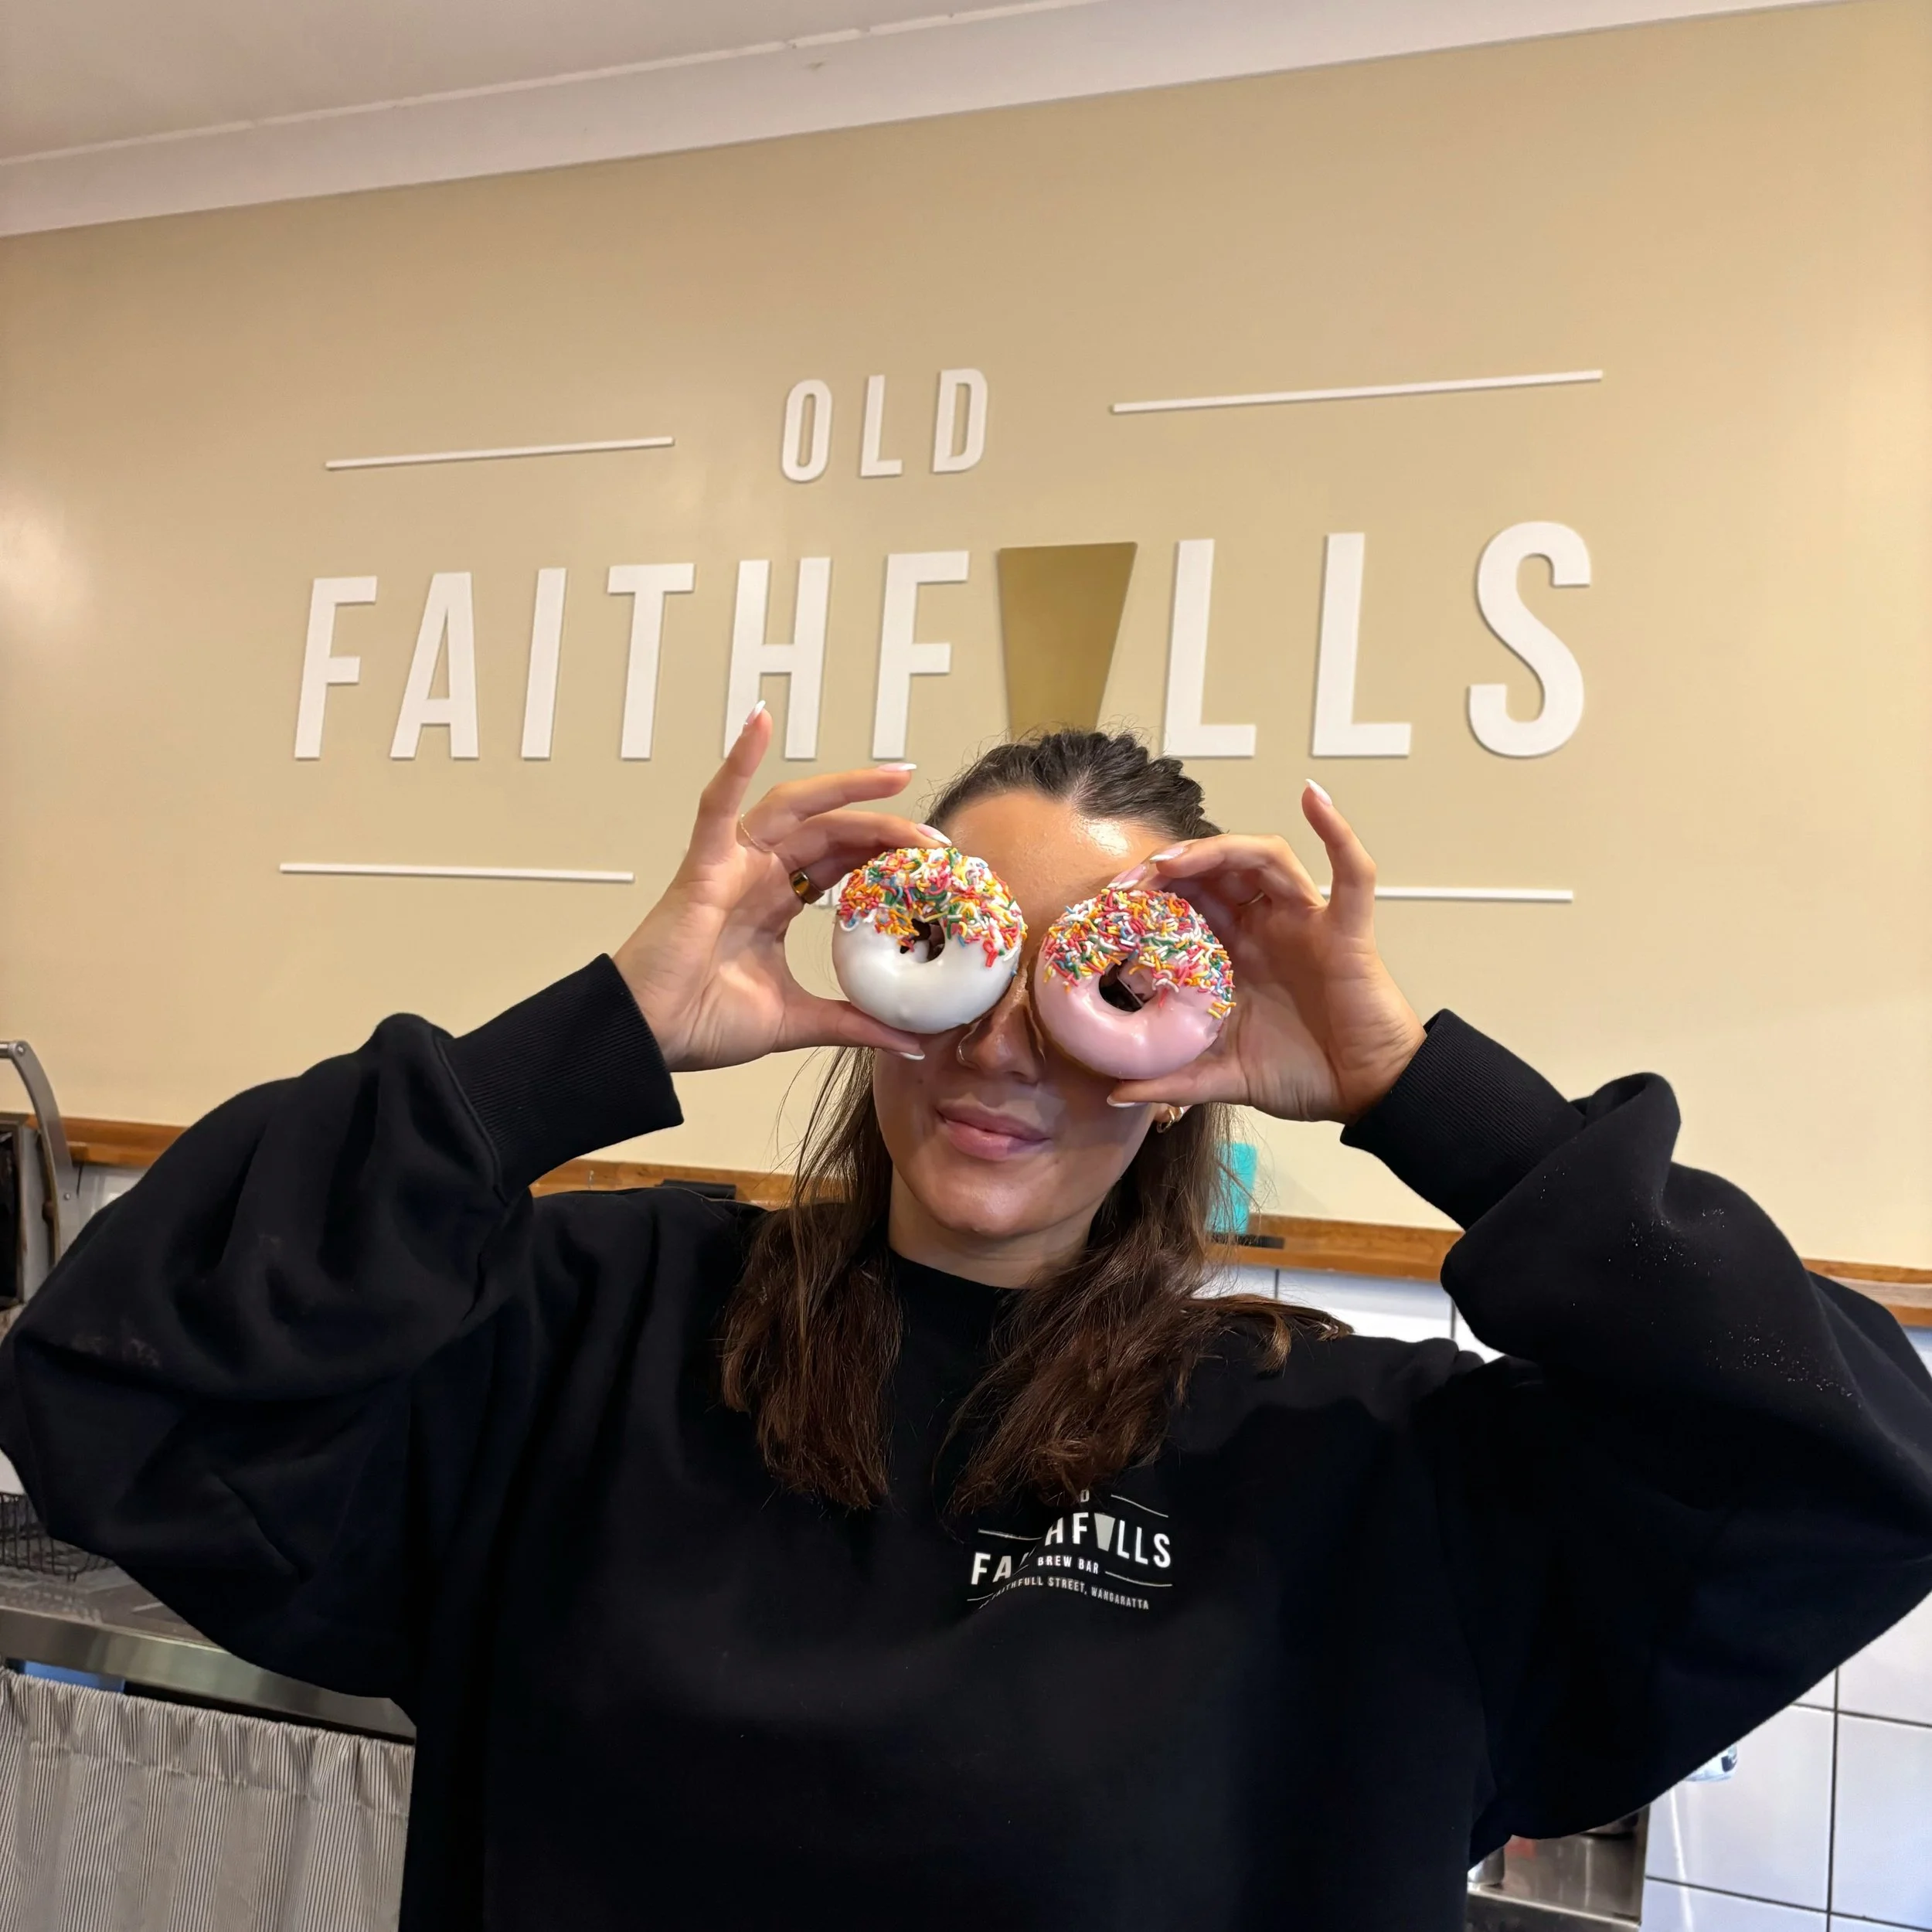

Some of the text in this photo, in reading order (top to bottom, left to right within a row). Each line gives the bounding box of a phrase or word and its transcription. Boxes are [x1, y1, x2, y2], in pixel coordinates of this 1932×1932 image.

[781, 367, 988, 482] OLD
[1037, 1555, 1099, 1574] BREW BAR
[1047, 1577, 1087, 1595] STREET,
[1090, 1586, 1149, 1610] WANGARATTA
